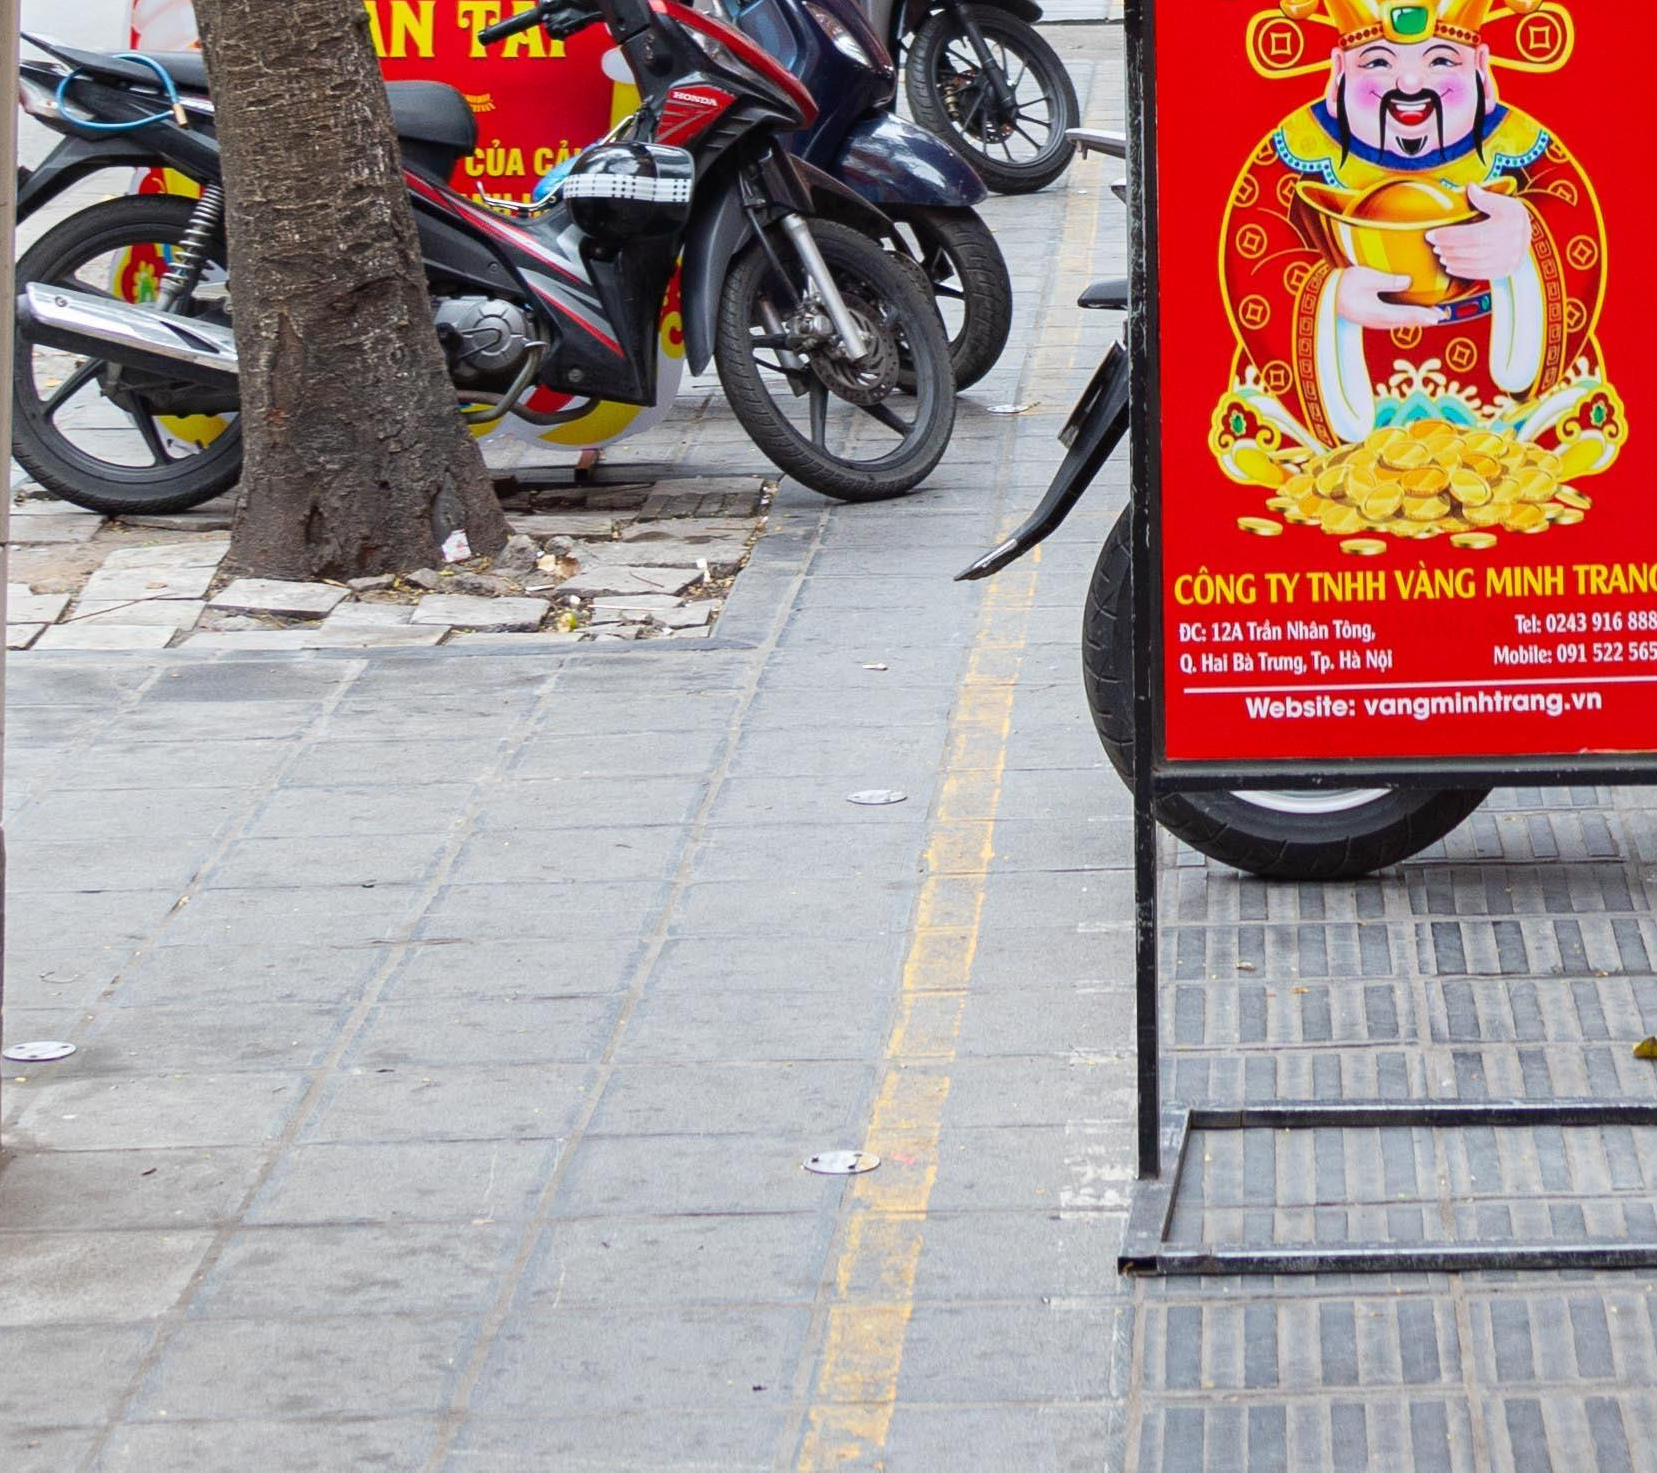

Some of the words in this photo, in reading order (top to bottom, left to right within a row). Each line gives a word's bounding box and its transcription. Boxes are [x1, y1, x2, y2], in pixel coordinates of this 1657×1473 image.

[672, 91, 718, 107] HONDA
[464, 139, 526, 177] CỦA
[1174, 565, 1257, 607] CÔNG
[1264, 572, 1298, 605] TY
[1309, 570, 1388, 603] TNHH
[1395, 561, 1476, 601] VÀNG
[1485, 563, 1566, 598] MINH
[1178, 622, 1209, 644] ĐC:
[1210, 621, 1243, 642] 12A
[1246, 617, 1285, 641] Trần
[1286, 619, 1330, 641] Nhân
[1514, 613, 1543, 634] Tel:
[1545, 612, 1588, 633] 0243
[1591, 611, 1625, 632] 916
[1179, 652, 1198, 674] Q.
[1201, 652, 1230, 674] Hai
[1232, 649, 1255, 673] Bà
[1257, 650, 1309, 677] Trưng,
[1310, 649, 1336, 675] Tp.
[1338, 647, 1362, 671] Hà
[1364, 647, 1394, 673] Nội
[1493, 643, 1554, 666] Mobile:
[1556, 643, 1589, 664] 091
[1592, 641, 1625, 663] 522
[1245, 692, 1357, 720] Website:
[1363, 689, 1603, 722] vangminhtrang.vn
